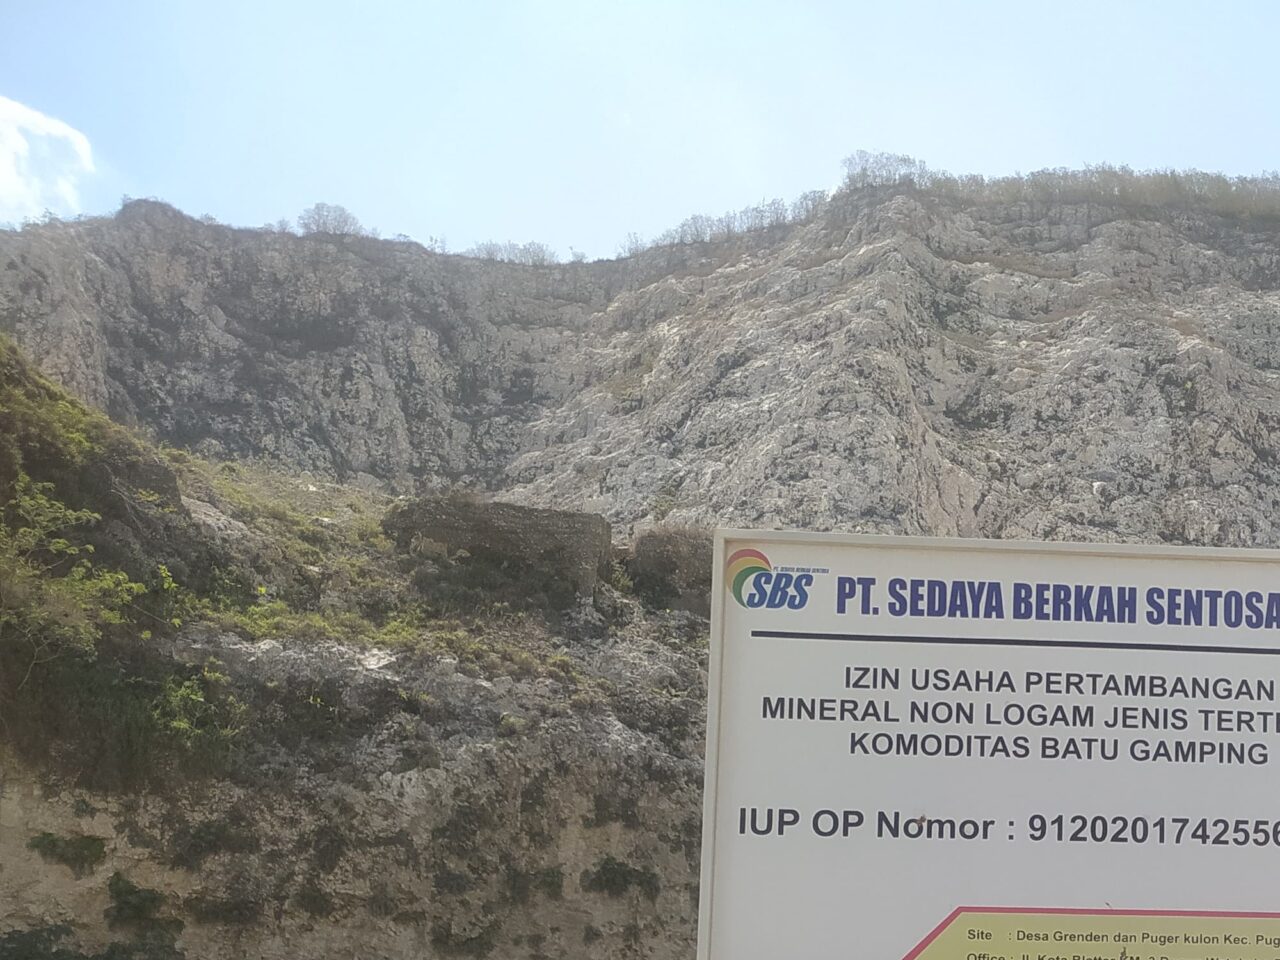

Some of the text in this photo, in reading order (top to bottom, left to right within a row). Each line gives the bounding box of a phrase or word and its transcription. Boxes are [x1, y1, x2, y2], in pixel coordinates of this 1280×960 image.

[746, 572, 814, 610] SBS
[836, 576, 880, 616] PT.
[887, 577, 1005, 620] SEDAYA
[1012, 582, 1137, 624] BERKAH
[845, 666, 1275, 702] IZIN USAHA PERTAMBANGAN
[762, 696, 900, 723] MINERAL
[910, 700, 974, 725] NON
[985, 702, 1094, 728] LOGAM
[1103, 706, 1188, 731] JENIS
[850, 732, 1268, 765] KOMODITAS BATU GAMPING
[739, 807, 800, 836] IUP
[812, 809, 865, 837] OP
[877, 810, 996, 840] Nomor
[967, 929, 993, 941] Site
[1016, 930, 1049, 942] Desa
[1052, 930, 1109, 943] Grenden
[1112, 932, 1137, 943] dan
[1141, 932, 1180, 947] Puger
[1183, 933, 1220, 945] kulon
[1223, 934, 1251, 945] Kec.
